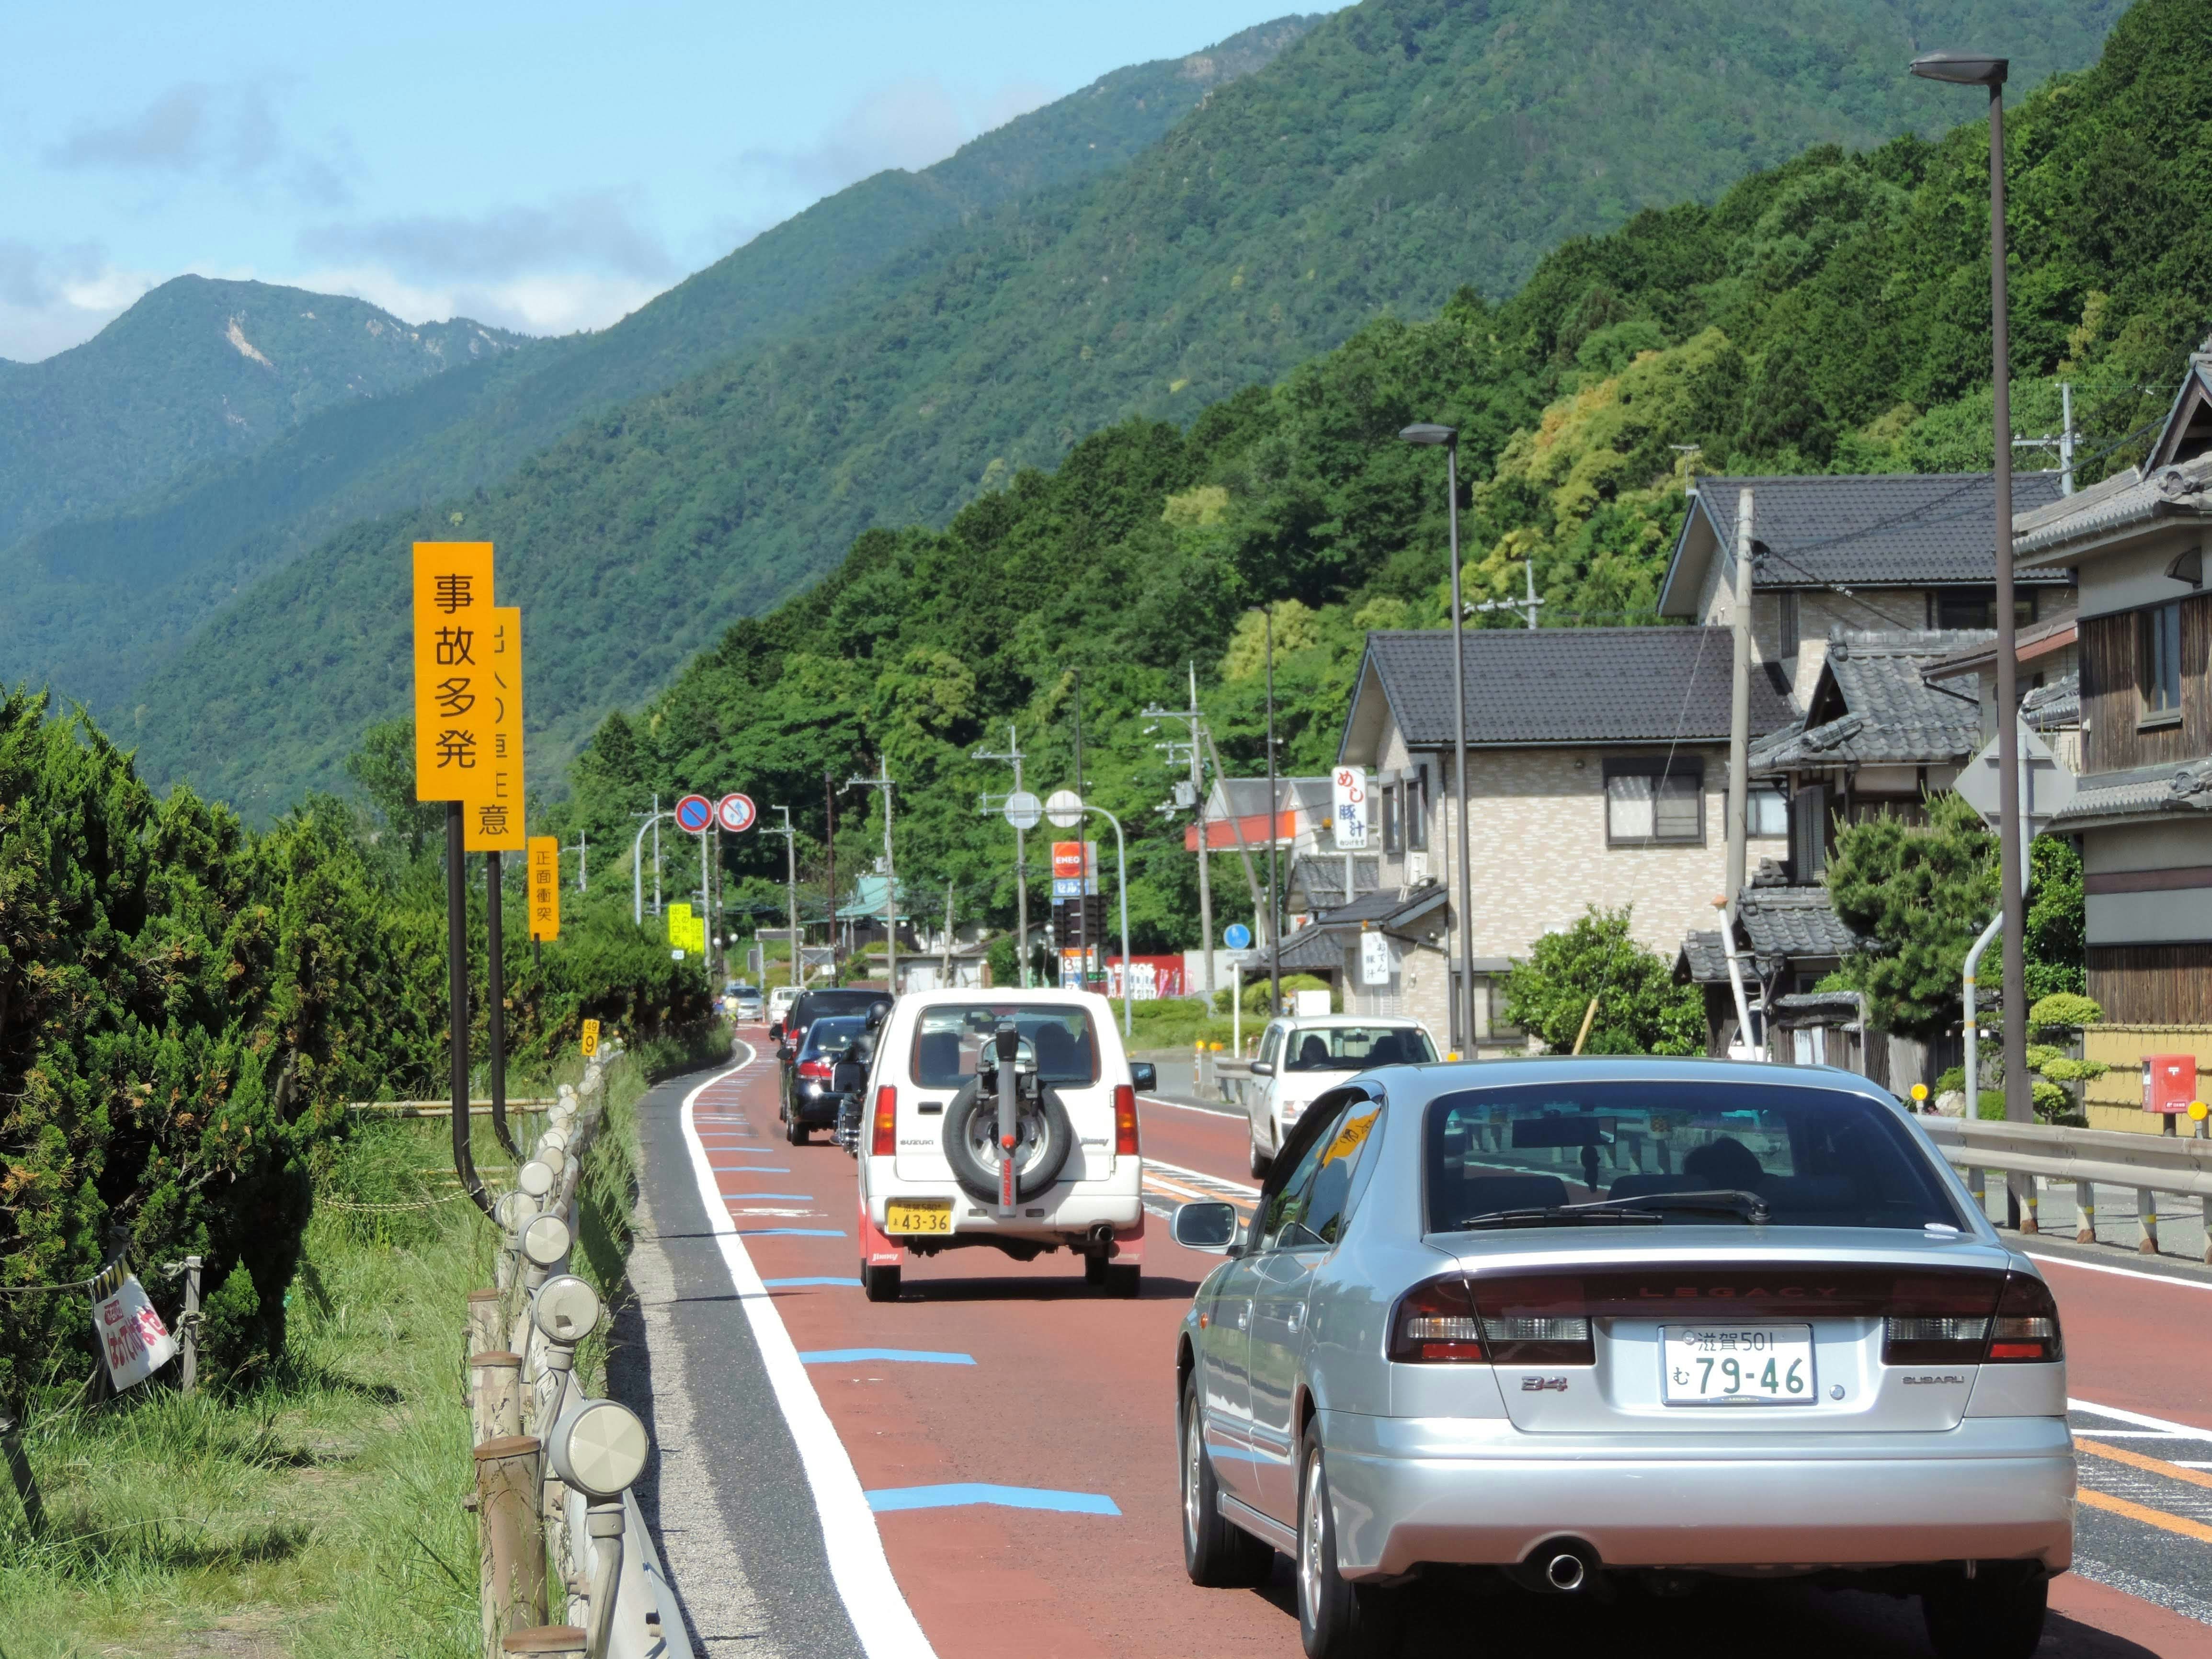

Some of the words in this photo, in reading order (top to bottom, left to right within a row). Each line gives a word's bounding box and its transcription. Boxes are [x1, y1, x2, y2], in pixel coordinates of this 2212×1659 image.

[434, 573, 476, 769] 事故多発
[1338, 770, 1364, 803] めし
[1339, 804, 1365, 837] 豚汁
[1056, 856, 1081, 864] ENEO
[536, 851, 551, 922] 正面衝突
[682, 906, 690, 933] この先
[1377, 943, 1386, 973] おでん
[1114, 963, 1154, 973] EEOS
[586, 1022, 597, 1032] 49
[585, 1035, 594, 1054] 9
[902, 1215, 947, 1230] 43-36
[872, 1253, 899, 1262] Jimny
[1640, 1287, 1837, 1297] LEGACY
[1698, 1332, 1774, 1351] 滋賀501
[1521, 1375, 1568, 1391] B4
[1673, 1366, 1690, 1386] む
[1696, 1357, 1804, 1394] 79-46
[1903, 1376, 1964, 1385] SUBARU
